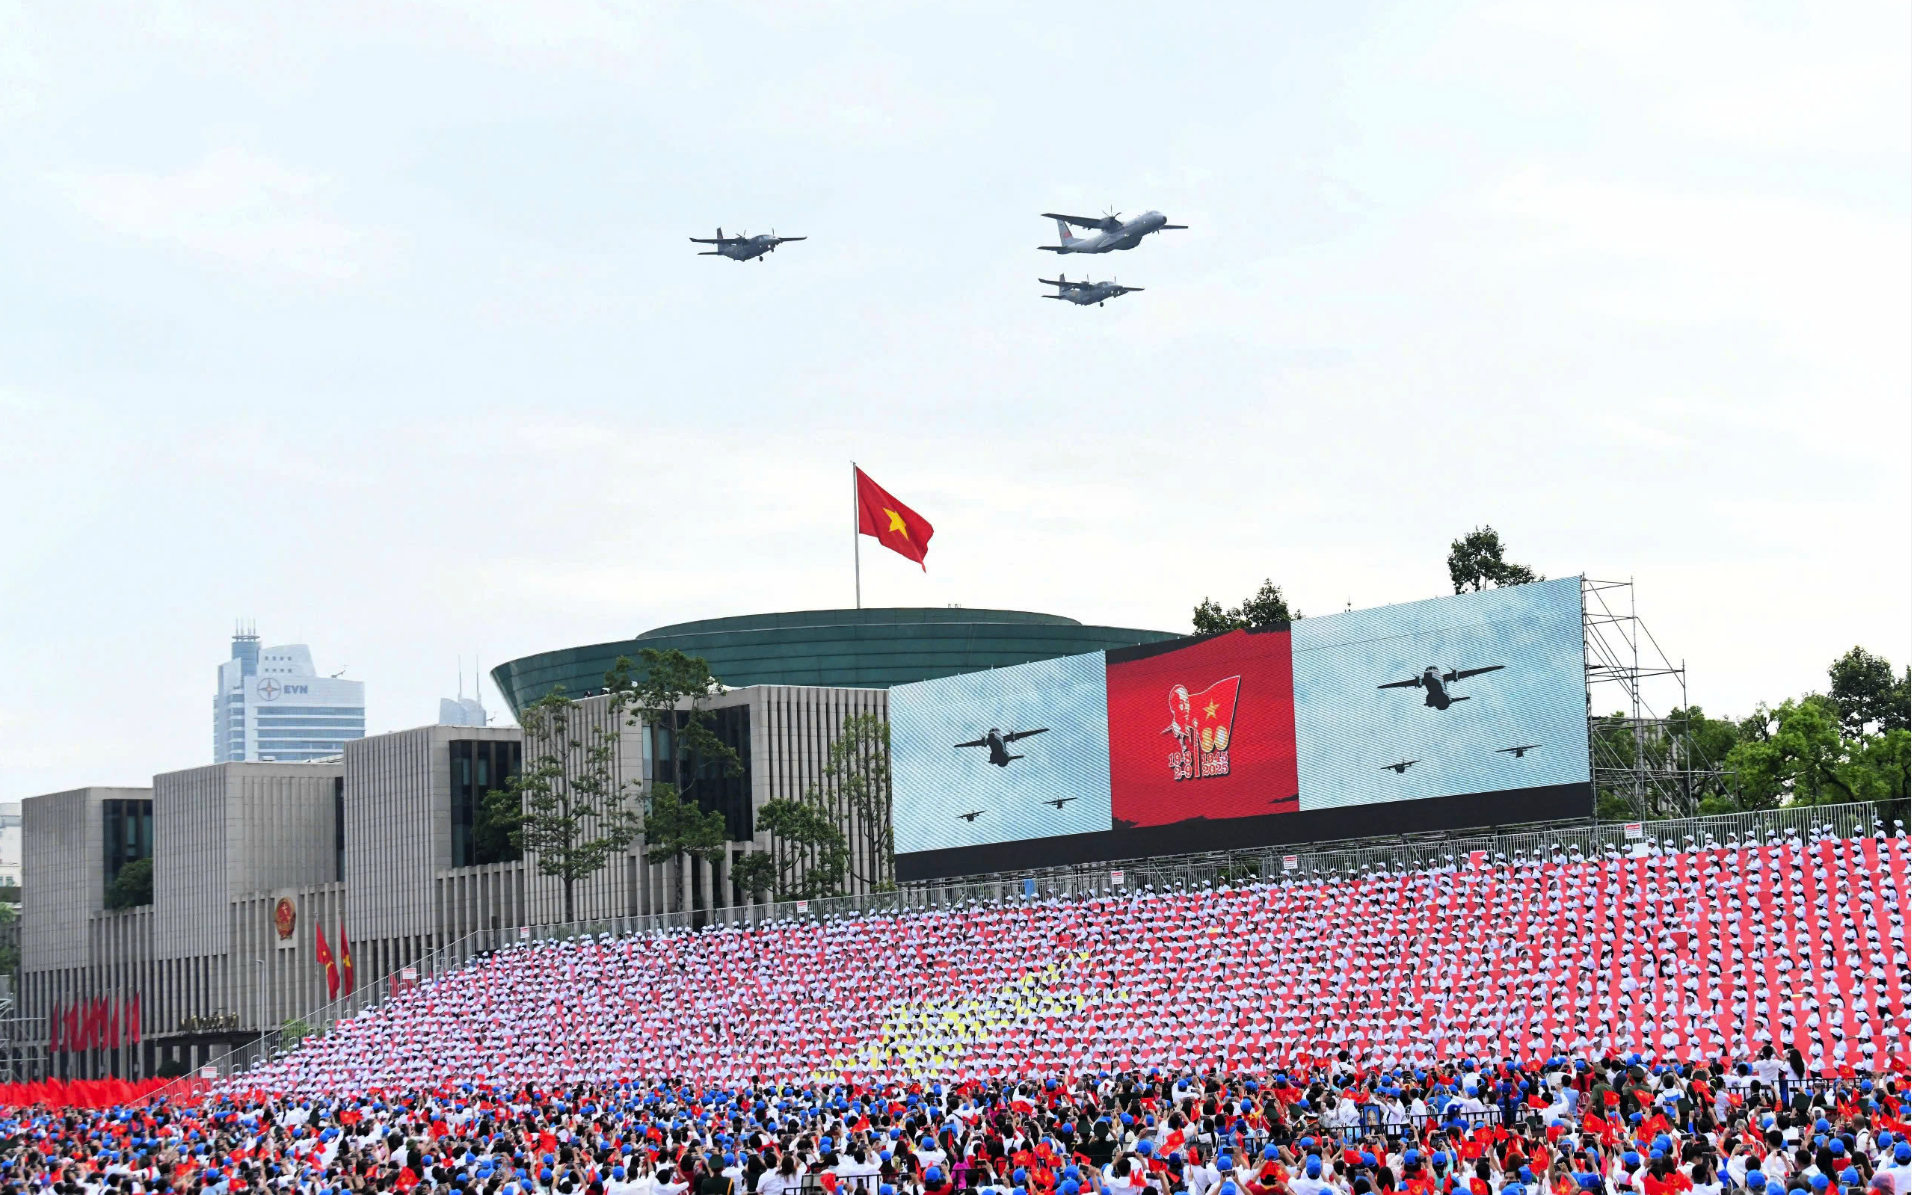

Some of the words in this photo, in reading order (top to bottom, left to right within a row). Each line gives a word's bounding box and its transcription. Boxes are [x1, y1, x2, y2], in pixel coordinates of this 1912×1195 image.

[284, 685, 308, 694] EVN
[1201, 751, 1228, 765] 1945
[1174, 764, 1192, 780] 2-9
[1201, 763, 1229, 776] 2025
